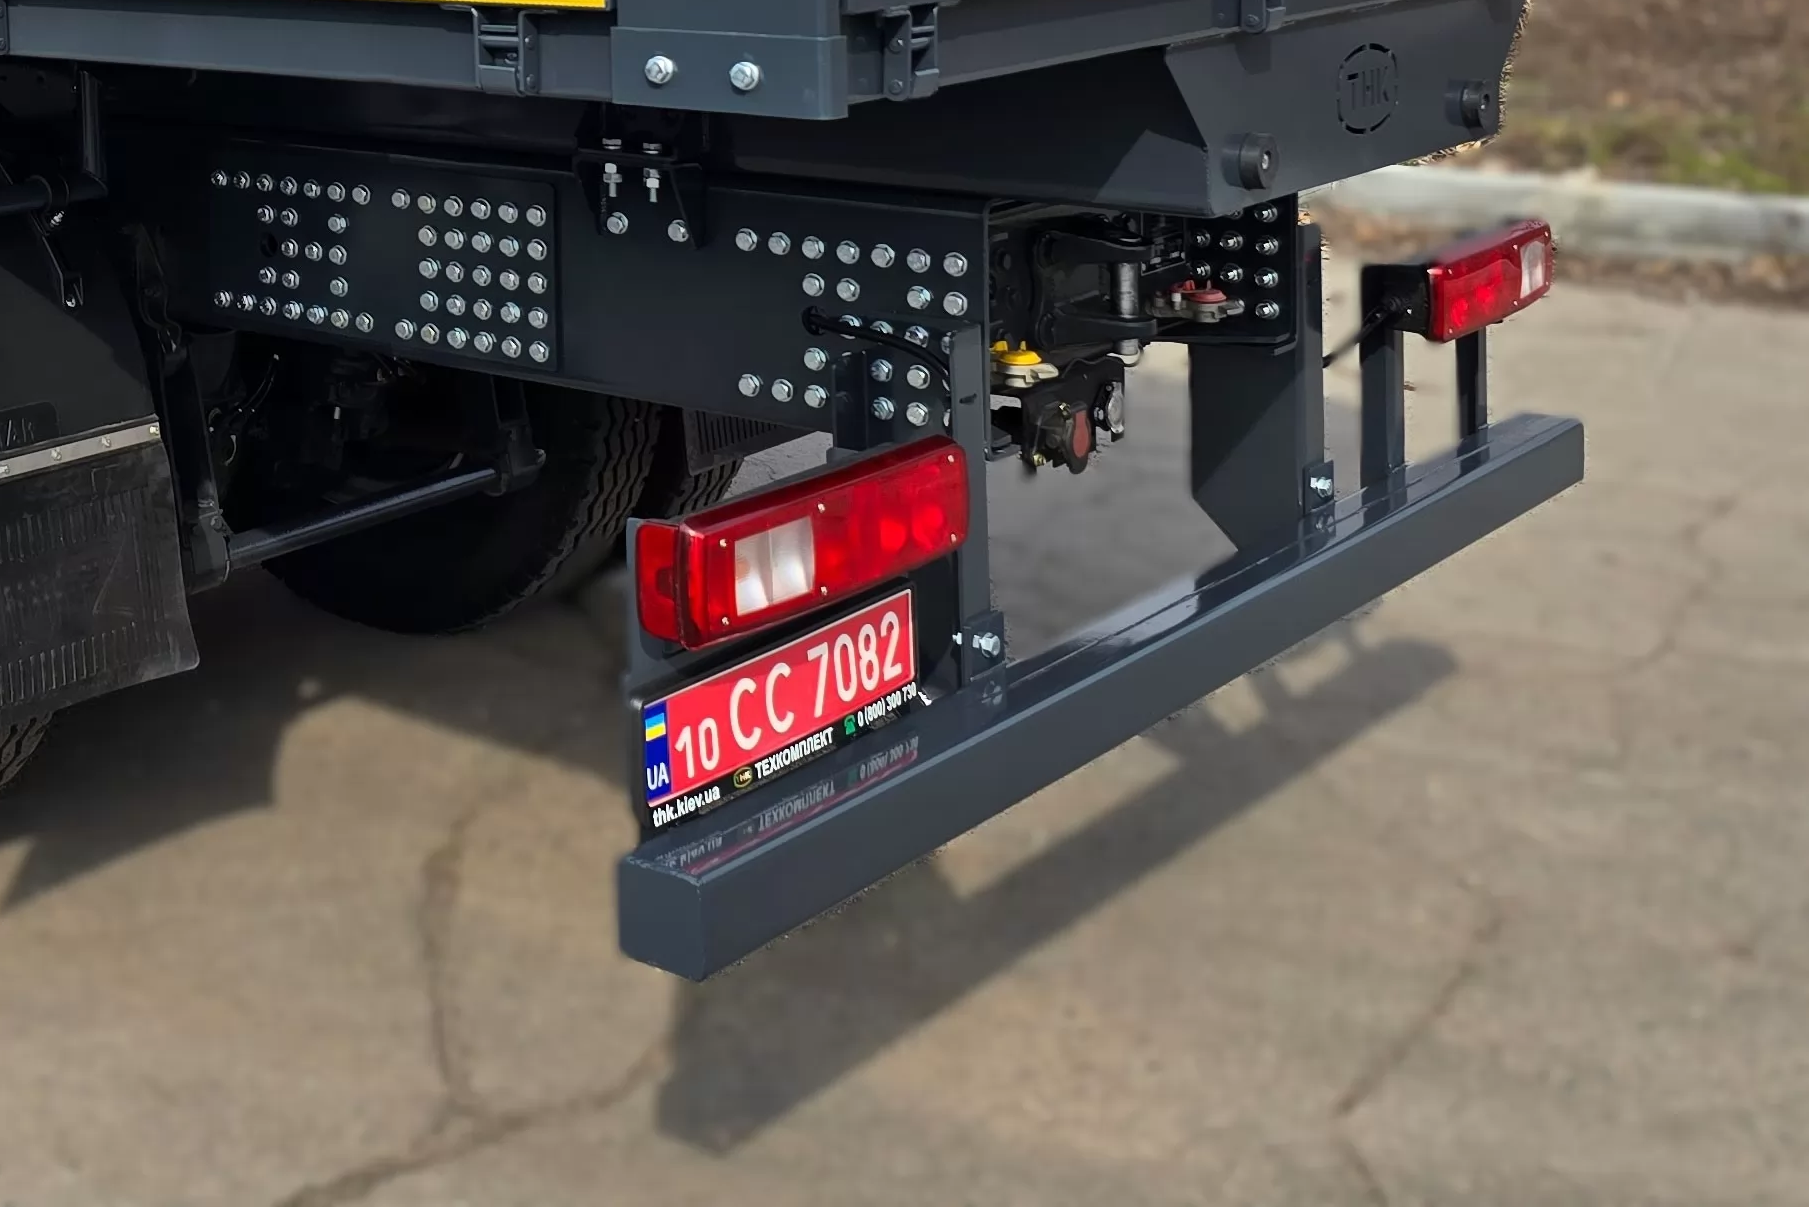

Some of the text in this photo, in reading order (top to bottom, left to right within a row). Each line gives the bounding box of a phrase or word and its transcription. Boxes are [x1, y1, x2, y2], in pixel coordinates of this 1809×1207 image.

[674, 611, 903, 778] 10 CC 7082
[857, 681, 917, 727] 0 (800) 300 730
[754, 726, 834, 779] ТЕХКОМПЛЕКТ
[646, 761, 670, 791] UA
[652, 785, 721, 828] thk.kiev.ua
